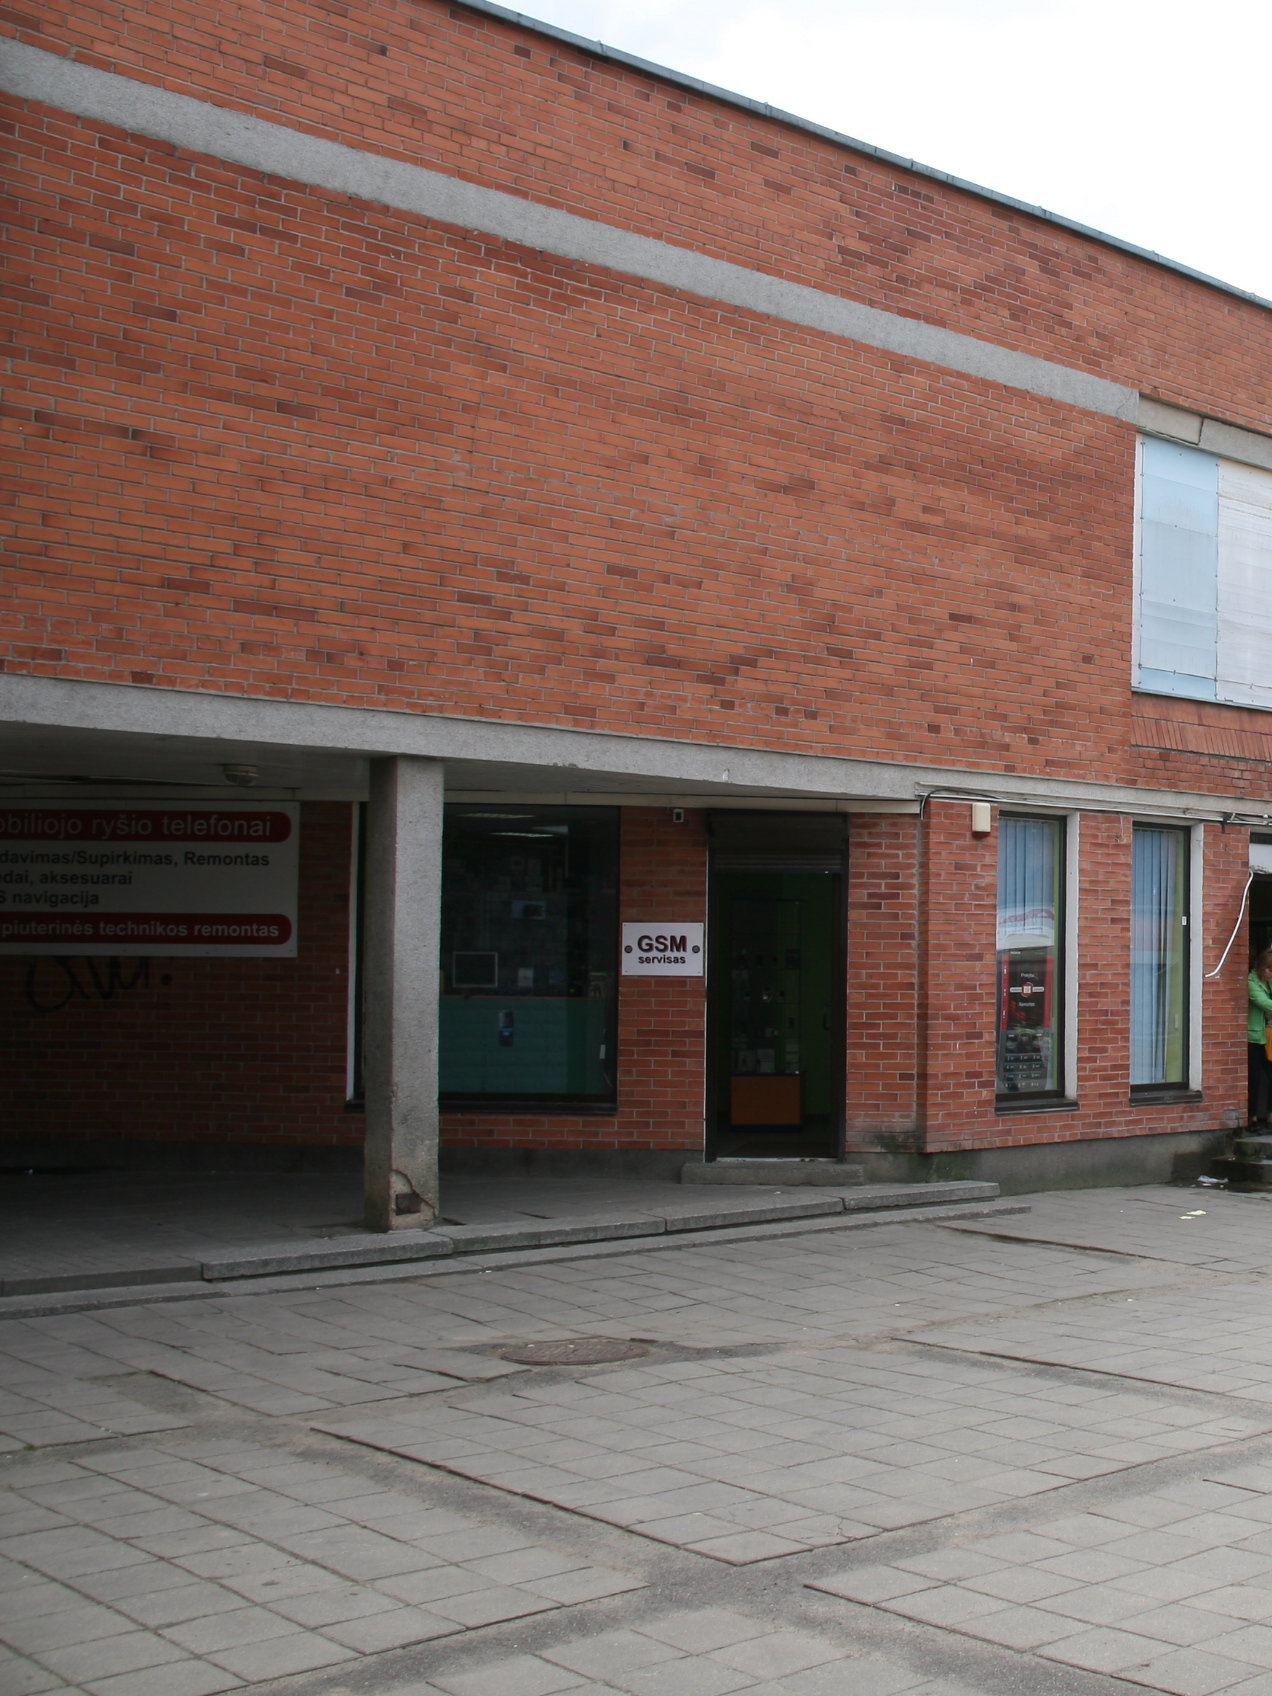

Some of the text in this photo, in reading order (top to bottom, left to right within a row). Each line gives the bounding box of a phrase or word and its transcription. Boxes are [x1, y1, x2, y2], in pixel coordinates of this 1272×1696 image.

[92, 814, 153, 839] ryšio
[161, 815, 271, 837] telefonai
[184, 852, 270, 866] Remontas
[0, 870, 132, 885] dai, aksesuarai
[12, 891, 99, 908] navigacija
[99, 921, 188, 937] technikos
[193, 923, 280, 937] remontas
[637, 935, 687, 953] GSM
[638, 954, 686, 964] servisas
